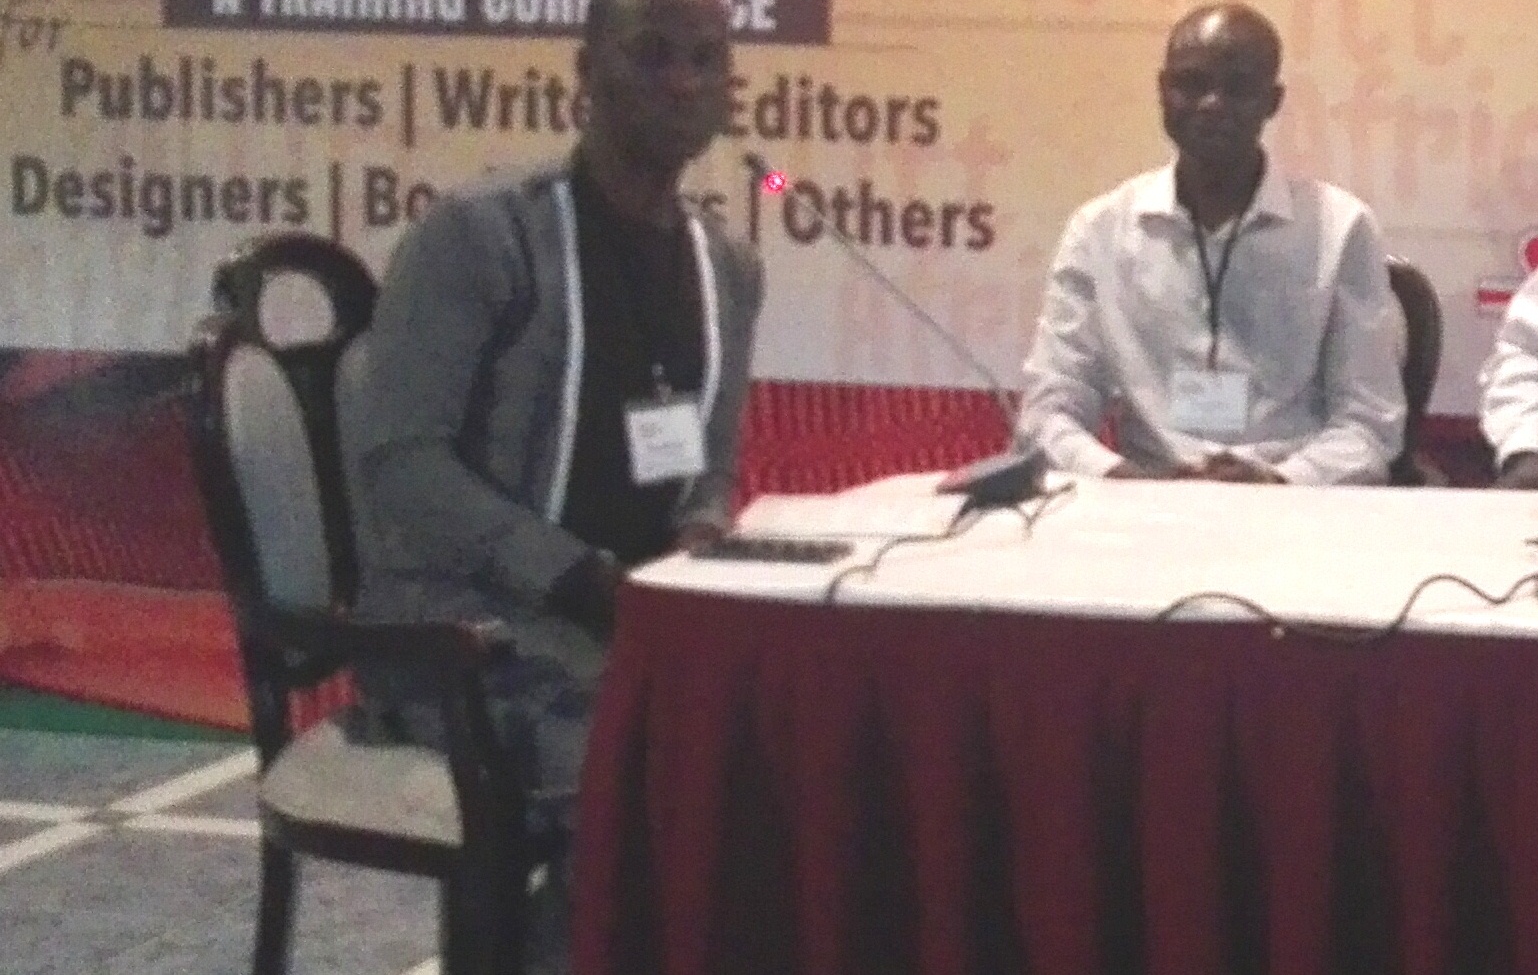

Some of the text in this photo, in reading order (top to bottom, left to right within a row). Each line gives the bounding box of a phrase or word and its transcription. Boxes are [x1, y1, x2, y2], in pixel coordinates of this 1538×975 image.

[61, 56, 385, 130] Publishers
[434, 66, 592, 132] Write
[11, 154, 311, 230] Designers
[781, 178, 997, 253] Others
